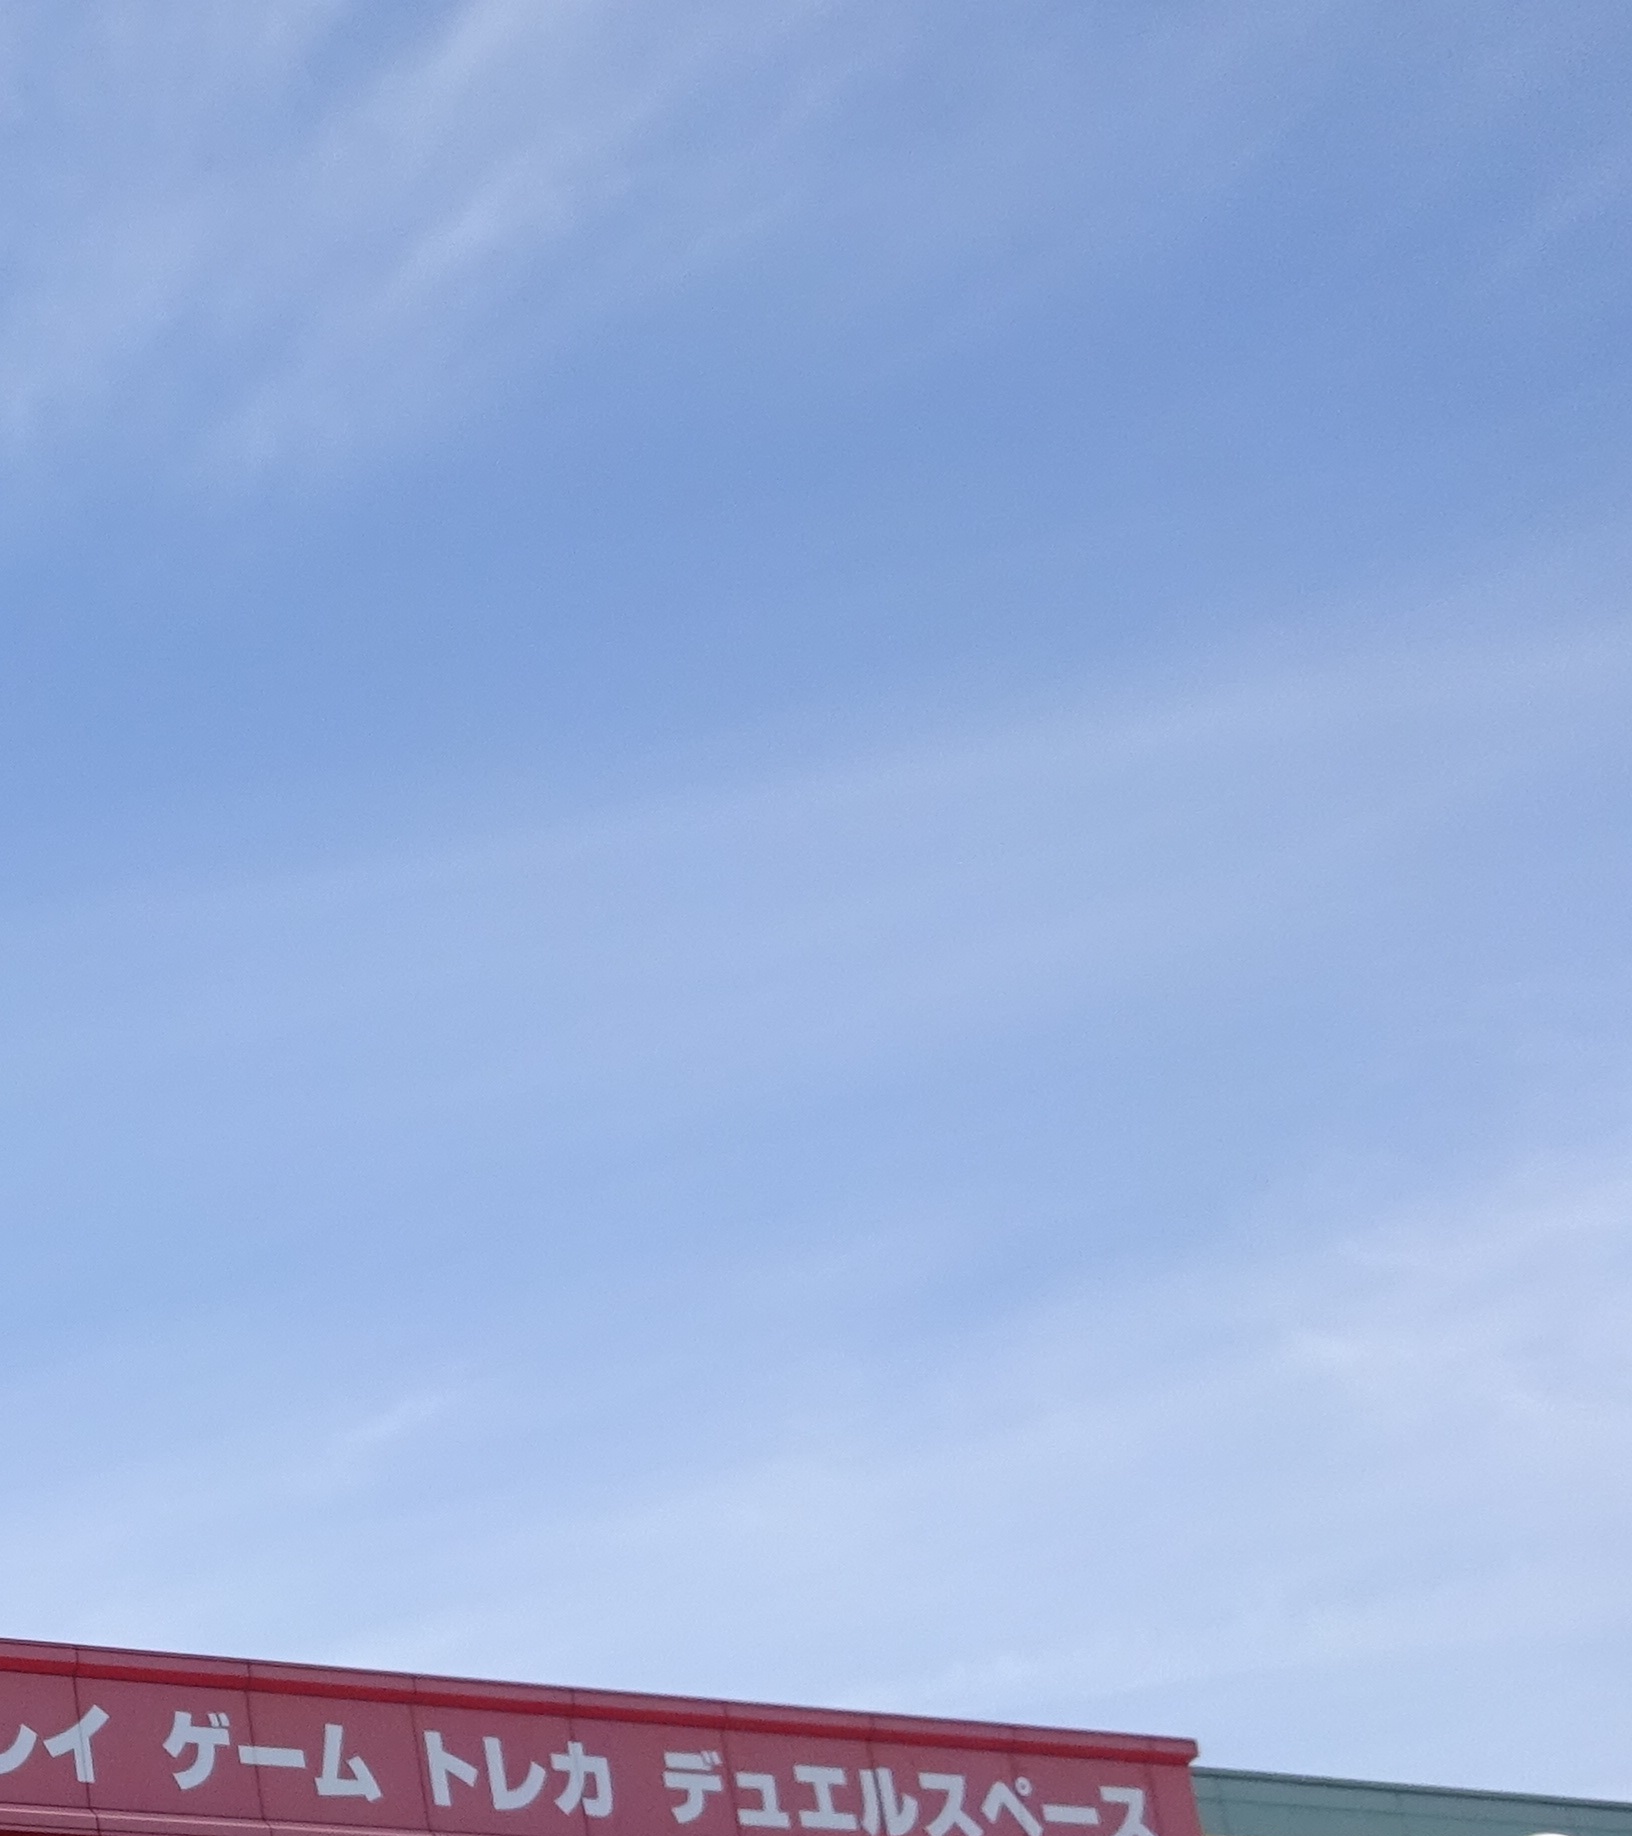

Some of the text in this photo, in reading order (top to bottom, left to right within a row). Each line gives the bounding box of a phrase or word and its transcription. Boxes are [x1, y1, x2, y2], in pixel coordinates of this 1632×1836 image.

[162, 1710, 383, 1802] ゲーム
[424, 1728, 613, 1818] トレカ
